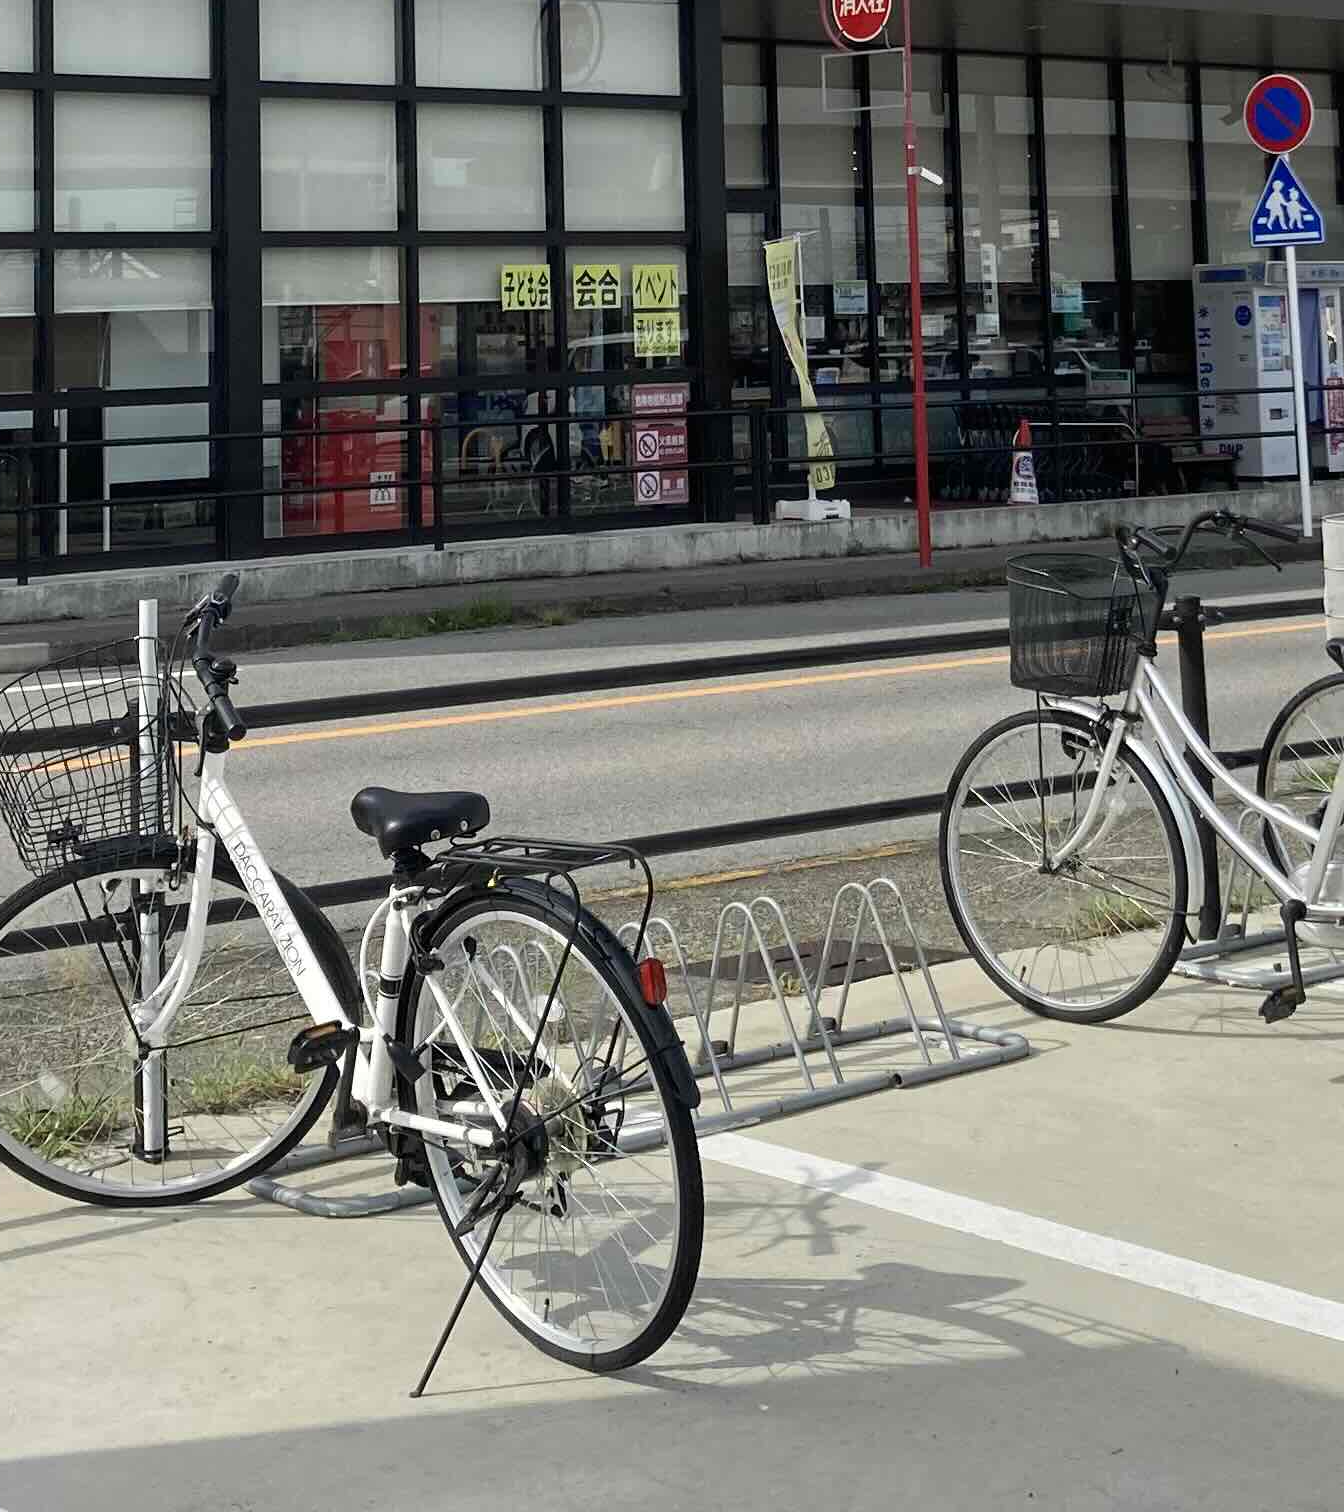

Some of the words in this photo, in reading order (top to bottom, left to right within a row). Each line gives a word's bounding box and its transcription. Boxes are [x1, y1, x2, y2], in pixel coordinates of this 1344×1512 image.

[504, 271, 549, 308] 子ども会
[575, 269, 619, 307] 会合
[634, 269, 677, 305] イベント
